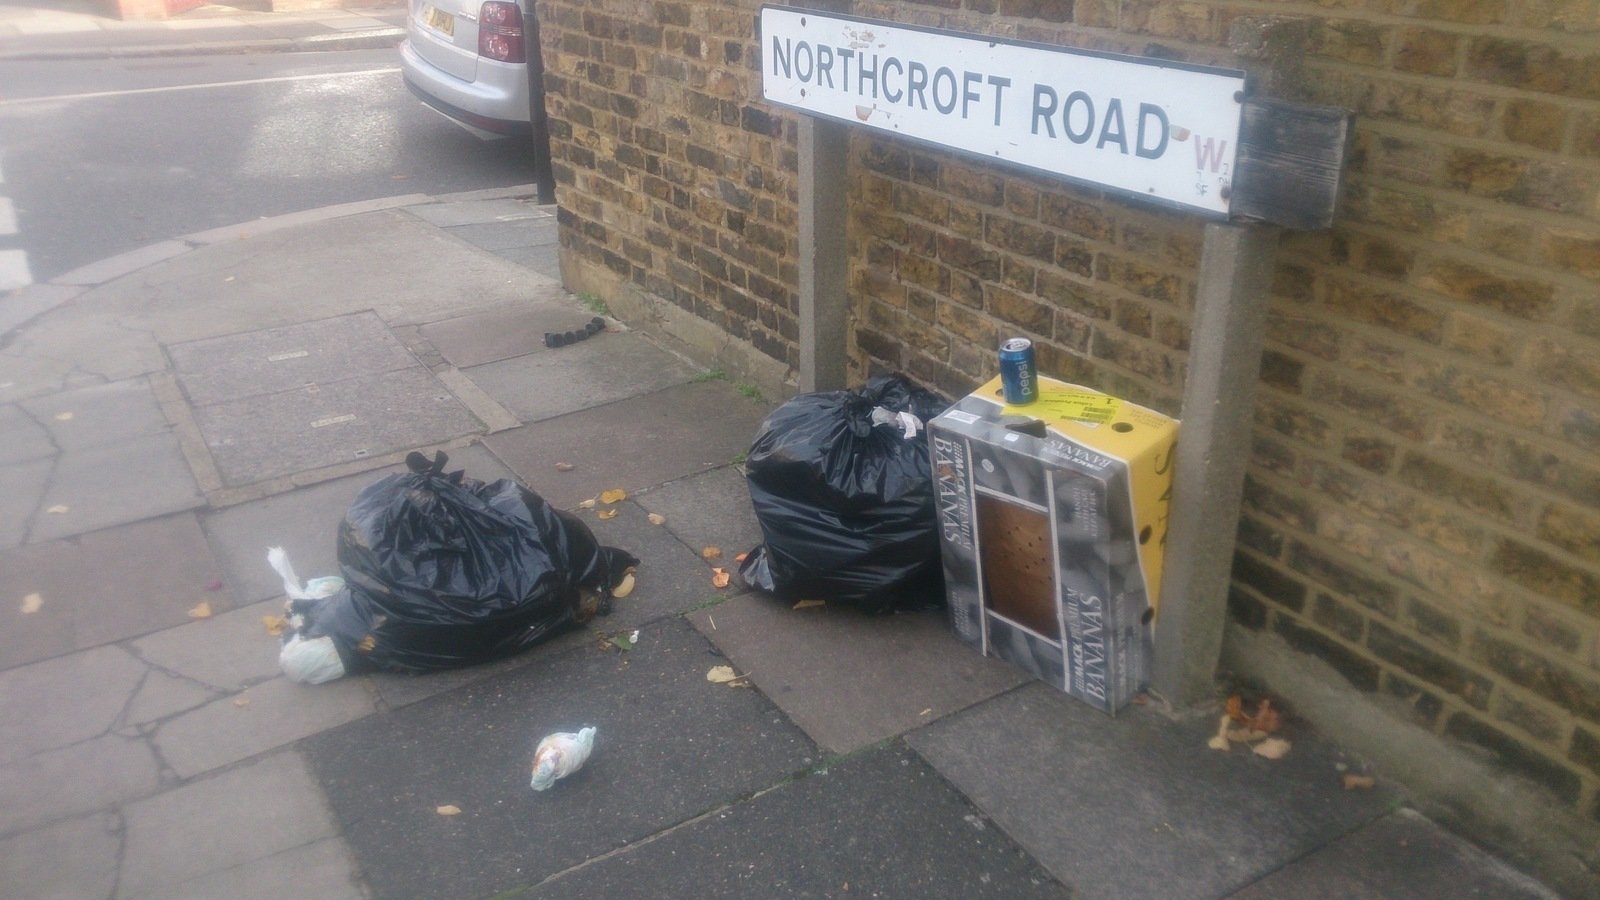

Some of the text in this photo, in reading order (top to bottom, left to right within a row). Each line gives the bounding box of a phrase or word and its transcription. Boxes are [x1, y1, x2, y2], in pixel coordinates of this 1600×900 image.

[772, 35, 1011, 127] NORTHCROFT
[1030, 83, 1171, 160] ROAD
[1015, 360, 1033, 396] pepsi
[933, 434, 961, 546] BANANAS
[954, 456, 967, 496] MACK
[1072, 642, 1085, 678] MACK
[1079, 592, 1106, 702] BANANAS
